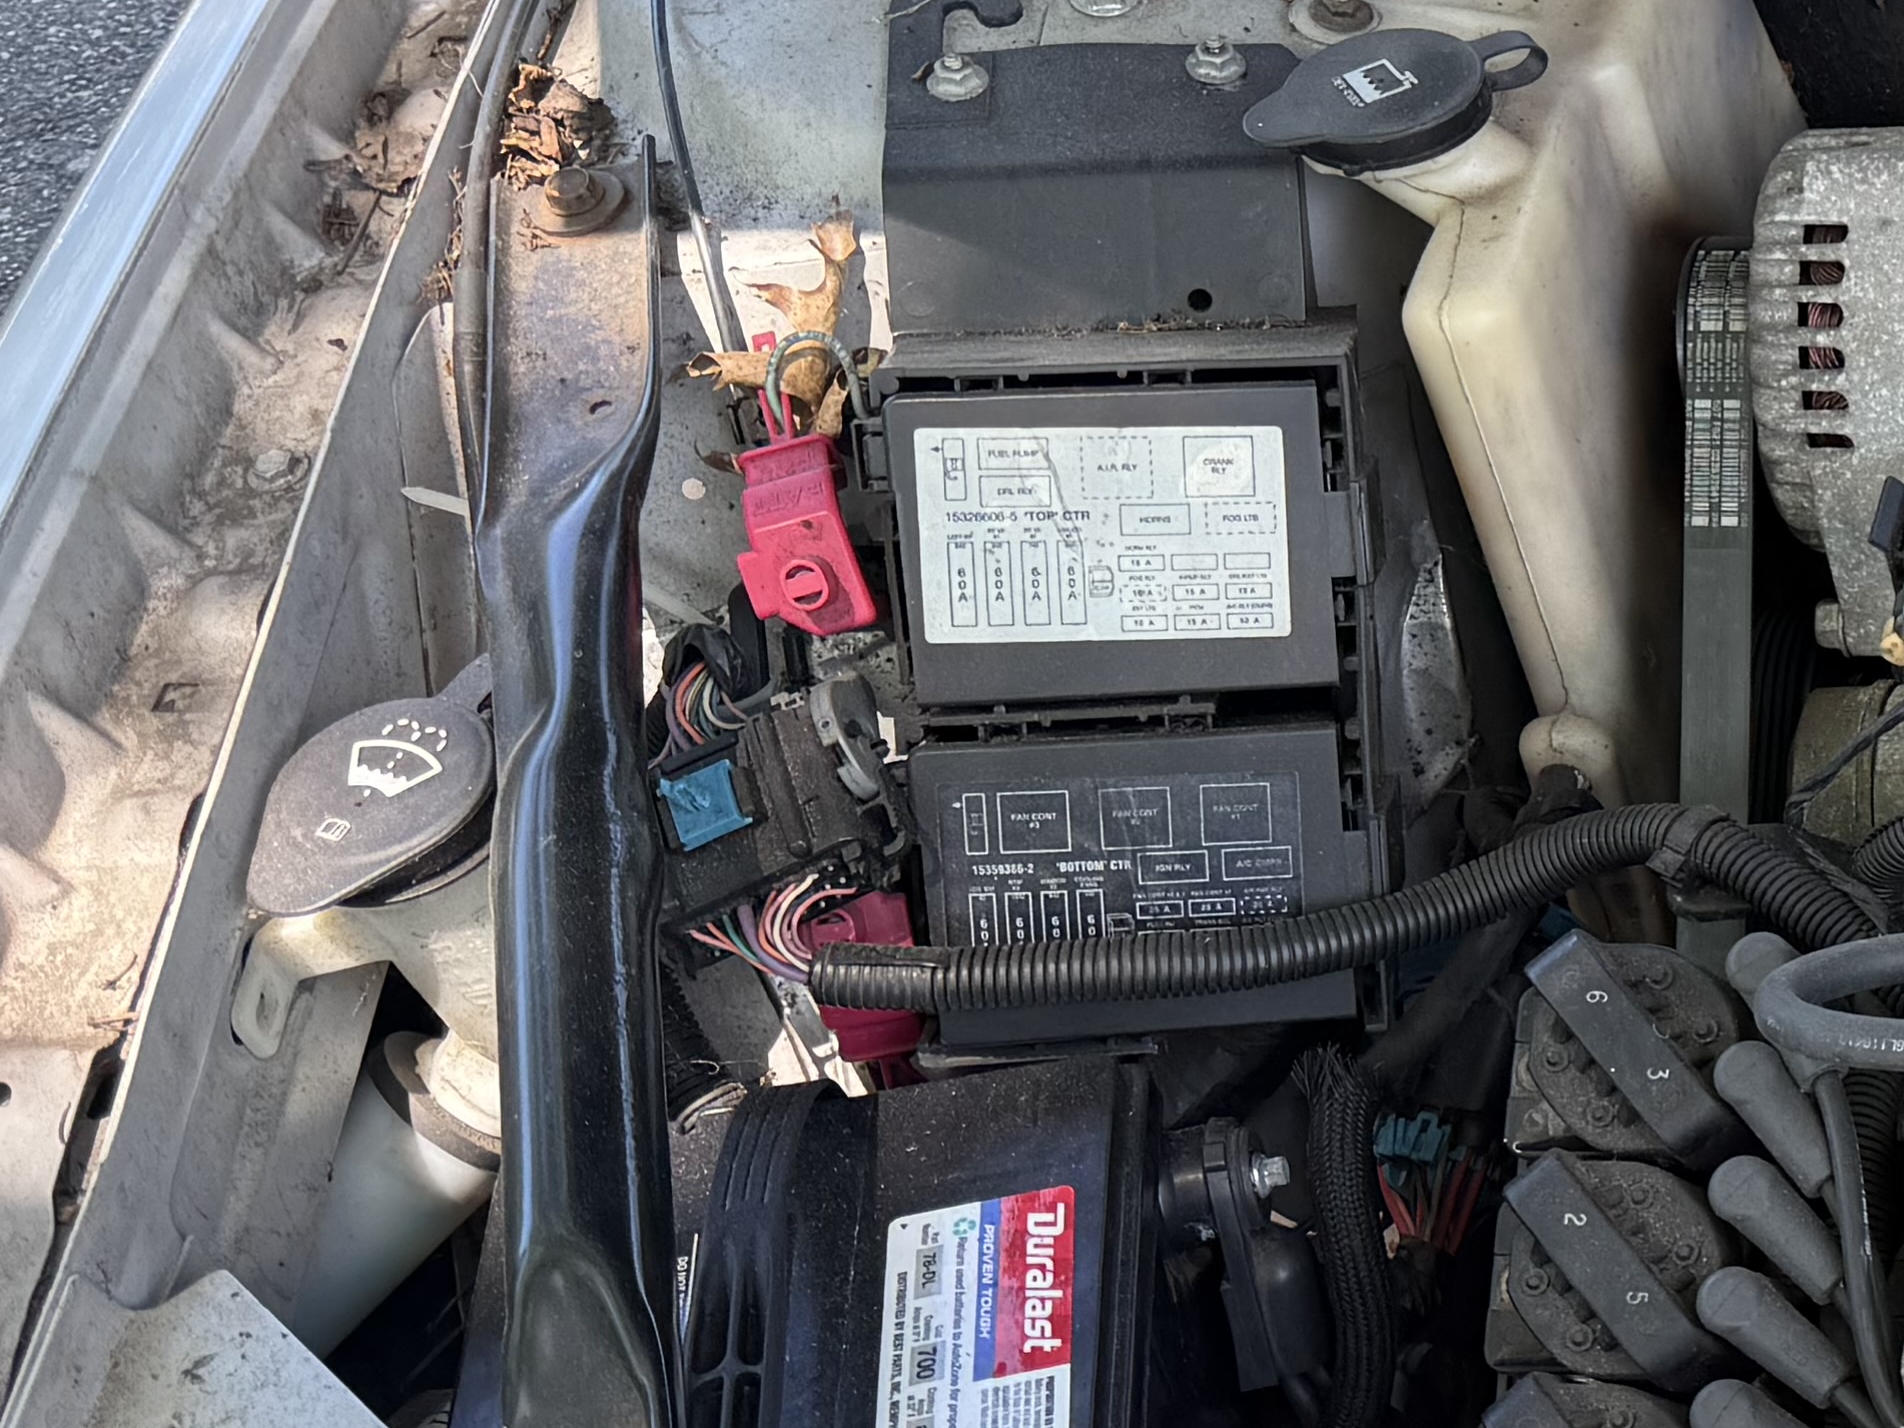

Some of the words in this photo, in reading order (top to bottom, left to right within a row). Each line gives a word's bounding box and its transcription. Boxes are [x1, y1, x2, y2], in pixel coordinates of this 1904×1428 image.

[987, 449, 1010, 458] FUEL
[1012, 449, 1040, 458] PUMP
[1121, 463, 1138, 472] RLY
[1202, 457, 1235, 467] CRANK
[1210, 466, 1227, 475] RLY
[1062, 510, 1091, 521] CTR
[1010, 813, 1030, 821] FAN
[1031, 812, 1057, 821] CONT
[1109, 859, 1132, 871] CTR
[1646, 1068, 1670, 1080] 3
[1563, 1213, 1588, 1226] 2
[980, 1223, 996, 1283] PROVEN
[1021, 1201, 1066, 1356] Duralast
[1625, 1291, 1650, 1305] 5
[977, 1286, 993, 1340] TOUGH
[914, 1344, 938, 1380] 700
